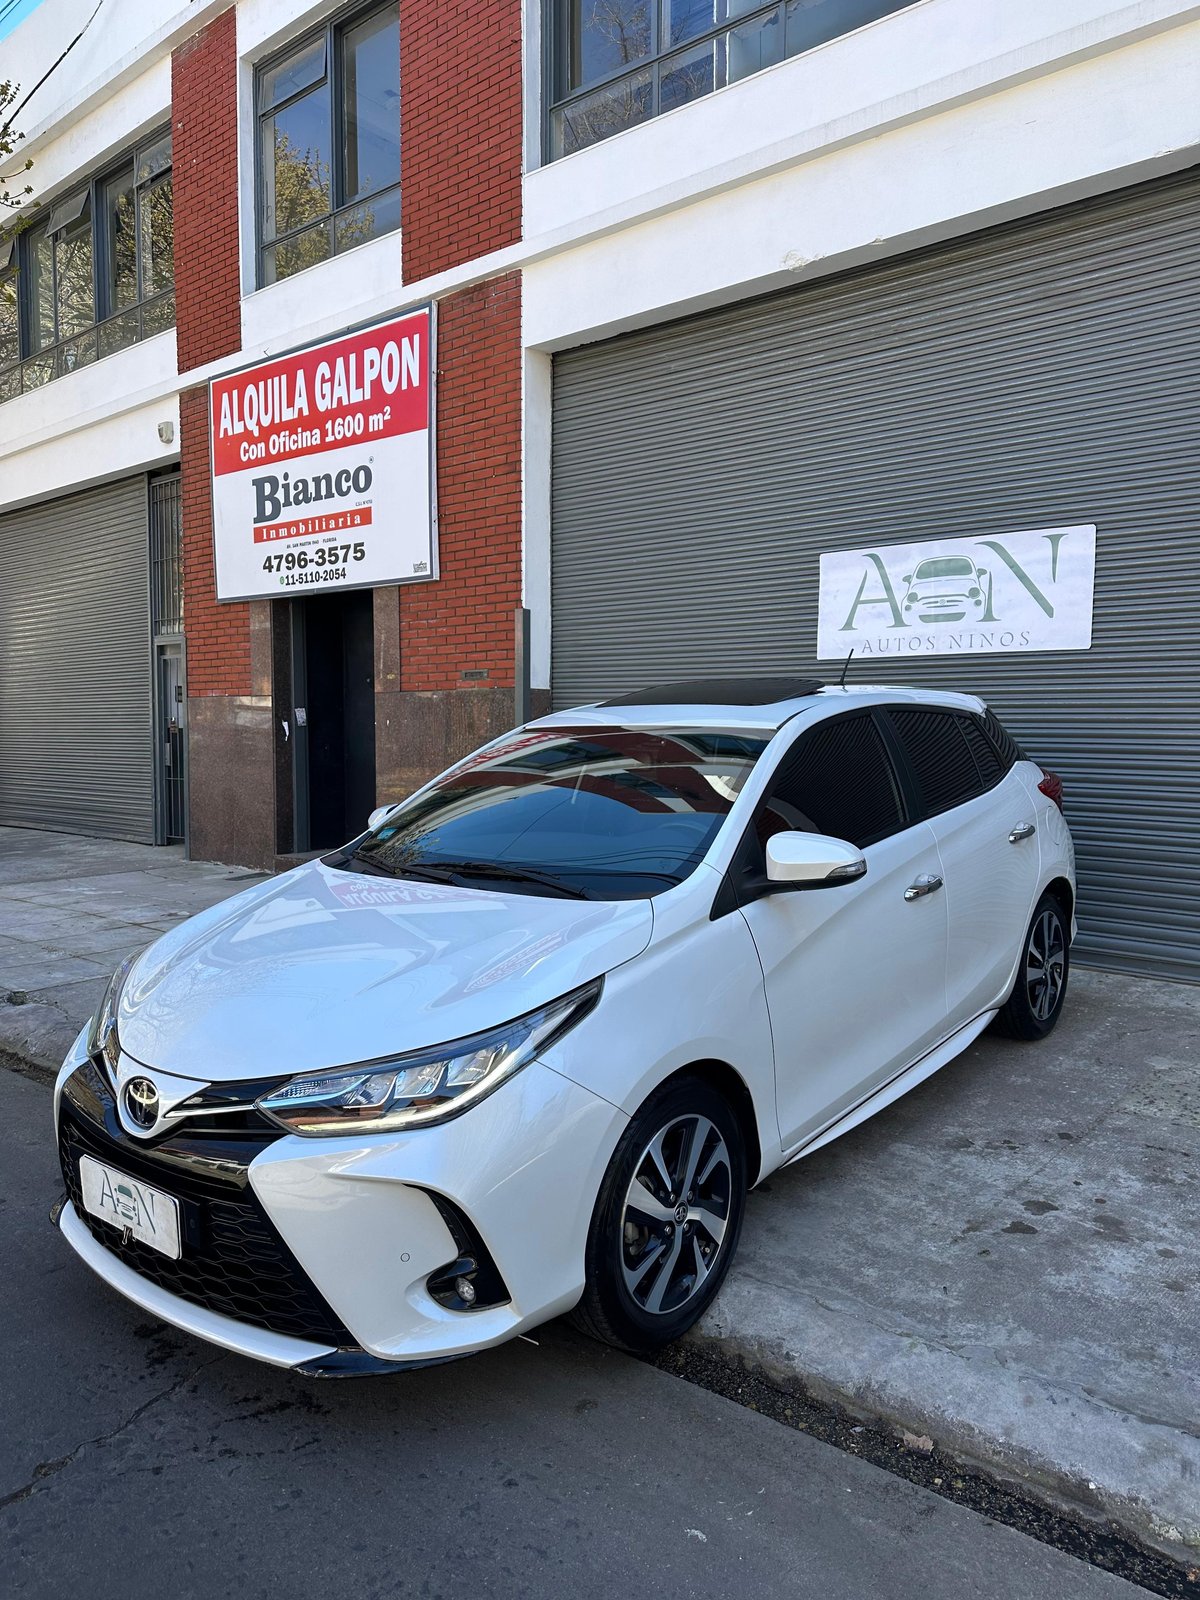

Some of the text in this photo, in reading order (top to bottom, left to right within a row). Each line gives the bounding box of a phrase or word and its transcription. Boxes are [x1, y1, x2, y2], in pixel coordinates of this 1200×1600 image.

[219, 333, 420, 438] ALQUILA GALPON
[240, 441, 266, 462] Con
[268, 427, 321, 453] Oficina
[325, 411, 364, 443] 1600
[252, 463, 373, 525] Bianco
[262, 512, 361, 540] Inmobiliaria
[262, 542, 366, 573] 4796-3575
[285, 568, 347, 586] 11-5110-2054
[861, 630, 1031, 653] AUTOS NINOS
